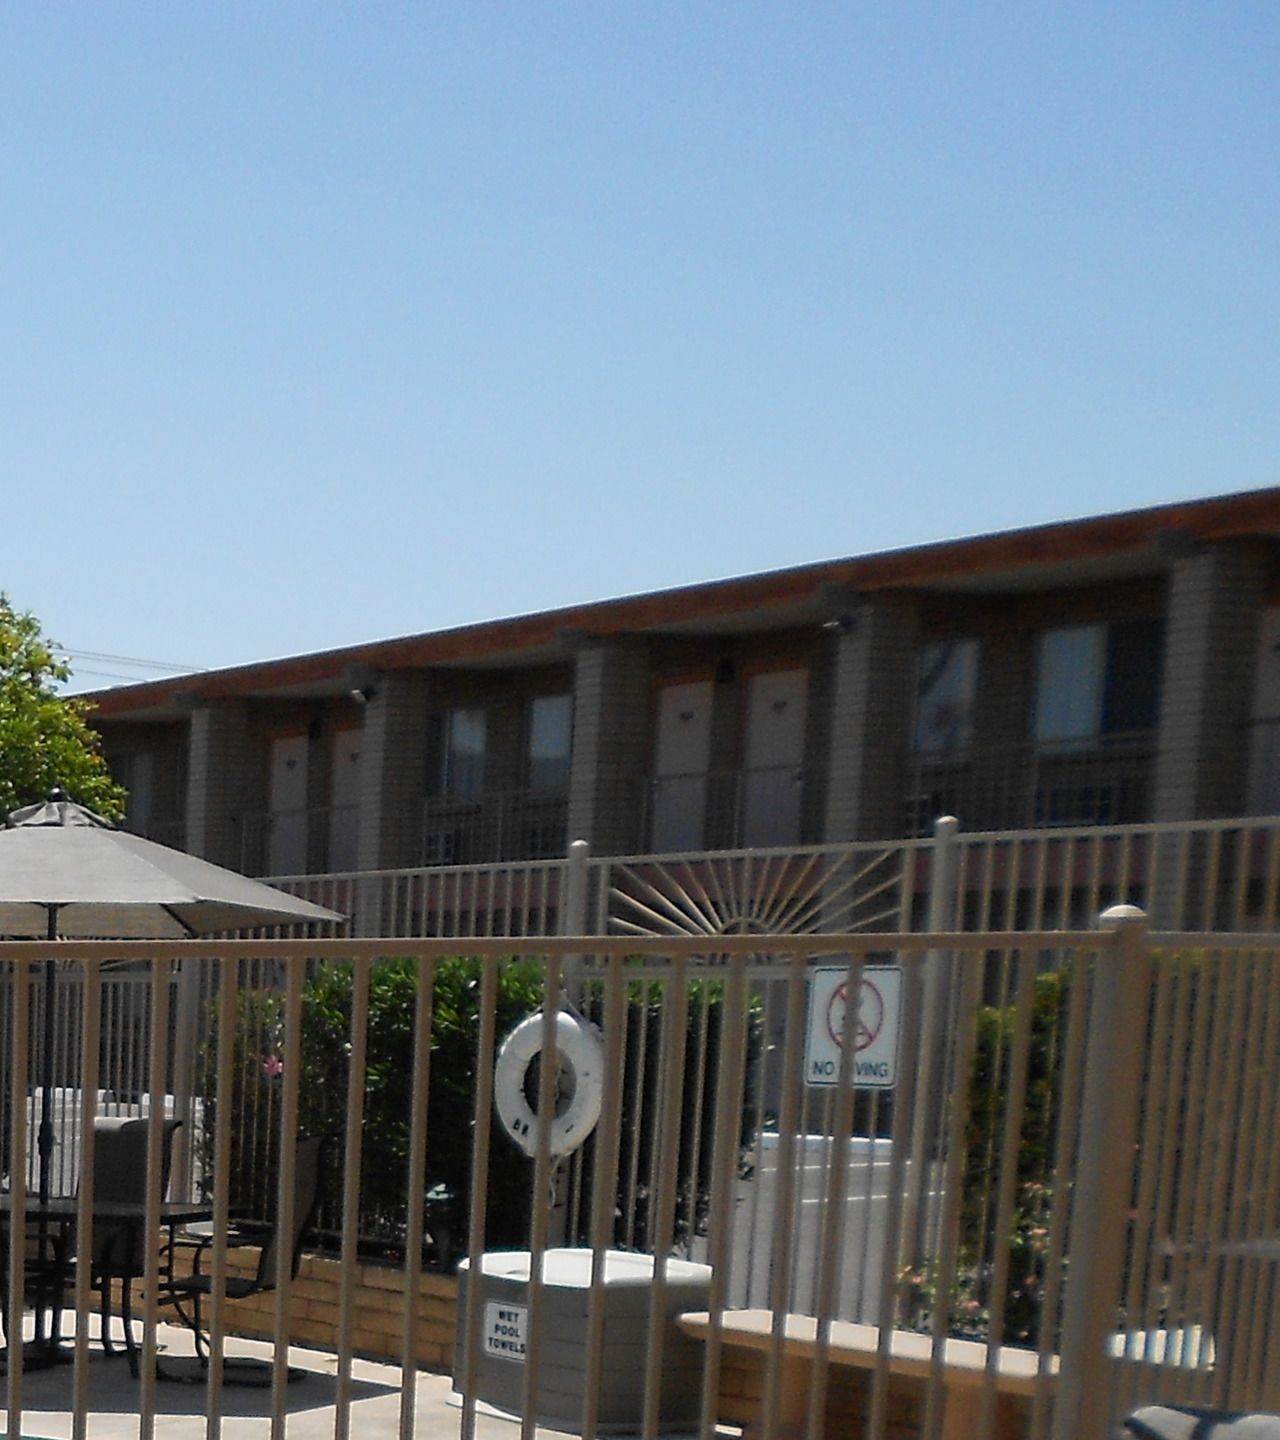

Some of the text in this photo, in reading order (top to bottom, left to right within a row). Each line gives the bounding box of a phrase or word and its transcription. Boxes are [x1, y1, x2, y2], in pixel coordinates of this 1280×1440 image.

[813, 1061, 889, 1077] NO VING
[498, 1311, 519, 1322] WET
[494, 1323, 520, 1337] POOL
[488, 1337, 526, 1353] TOWELS
